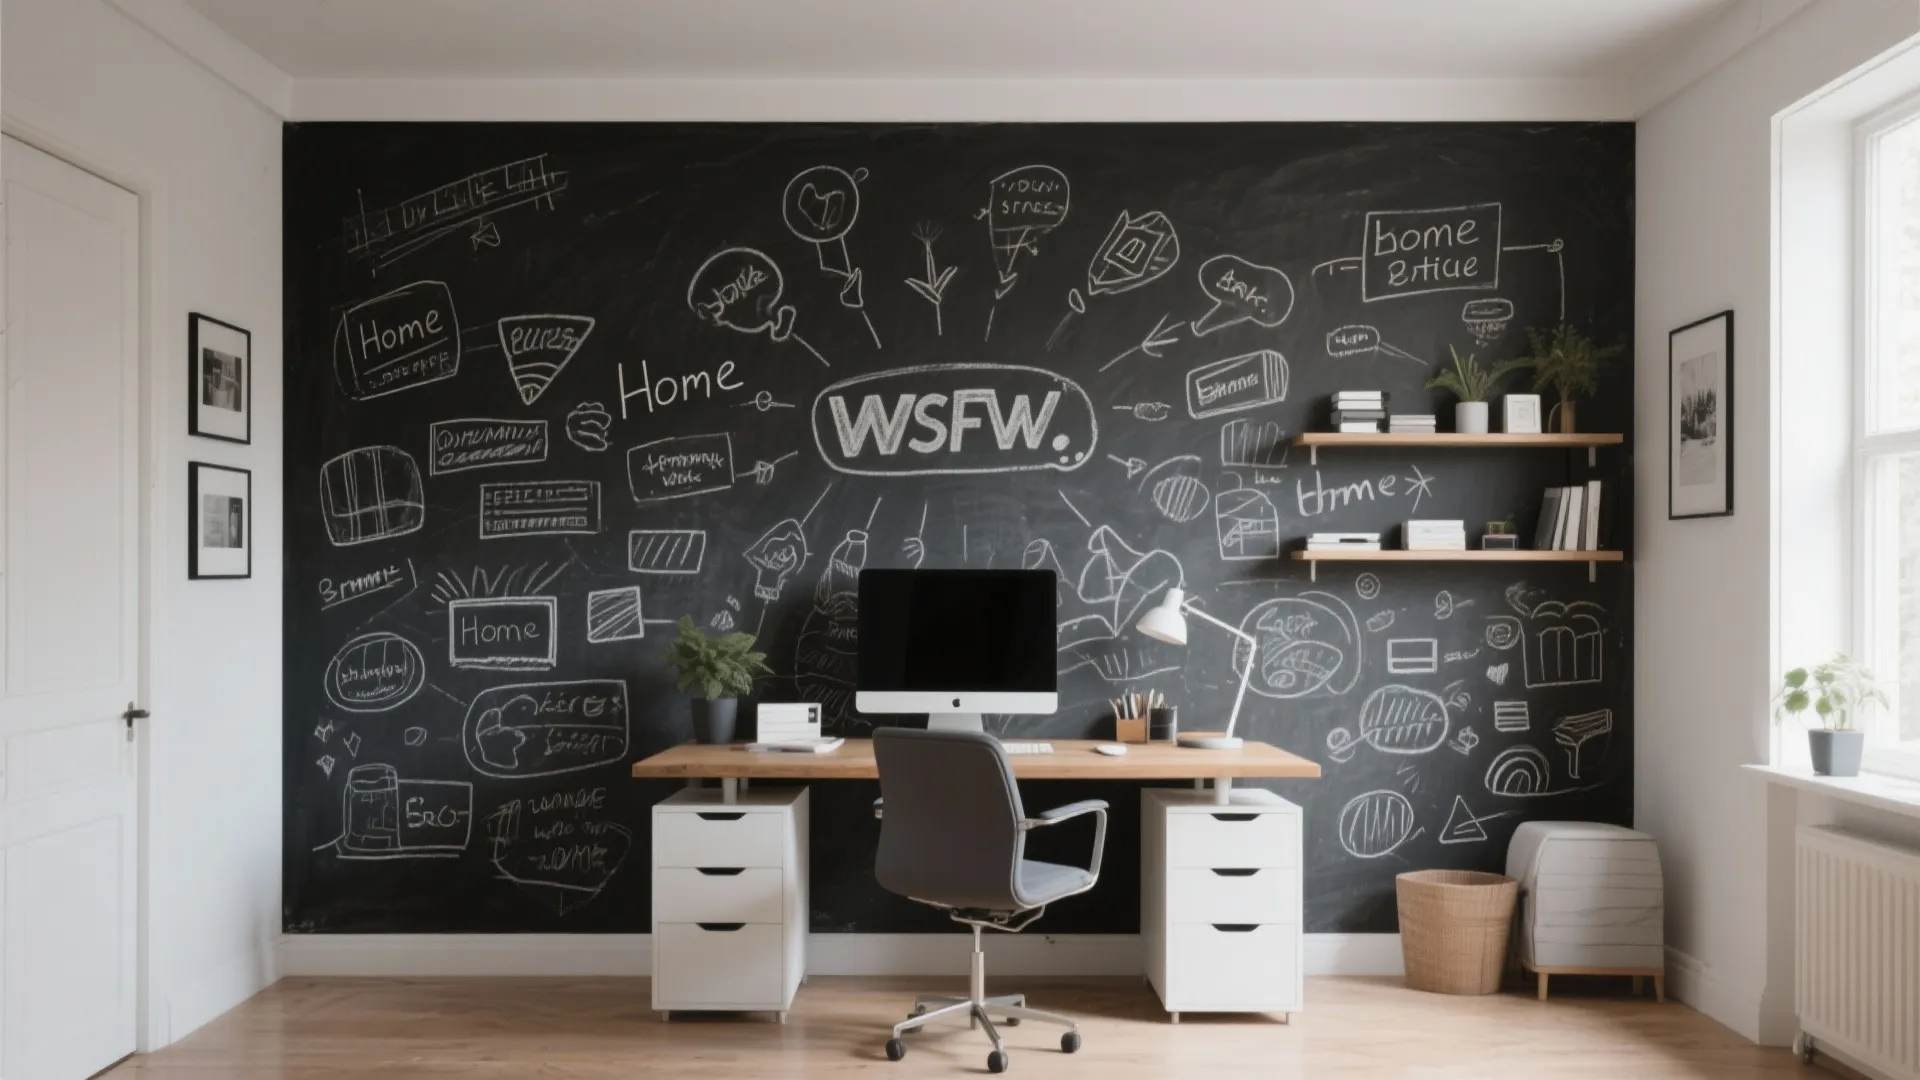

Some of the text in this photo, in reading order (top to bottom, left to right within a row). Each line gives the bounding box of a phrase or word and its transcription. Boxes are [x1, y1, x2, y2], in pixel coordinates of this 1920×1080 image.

[360, 309, 443, 360] Home
[618, 360, 744, 419] Home
[462, 614, 540, 646] Home
